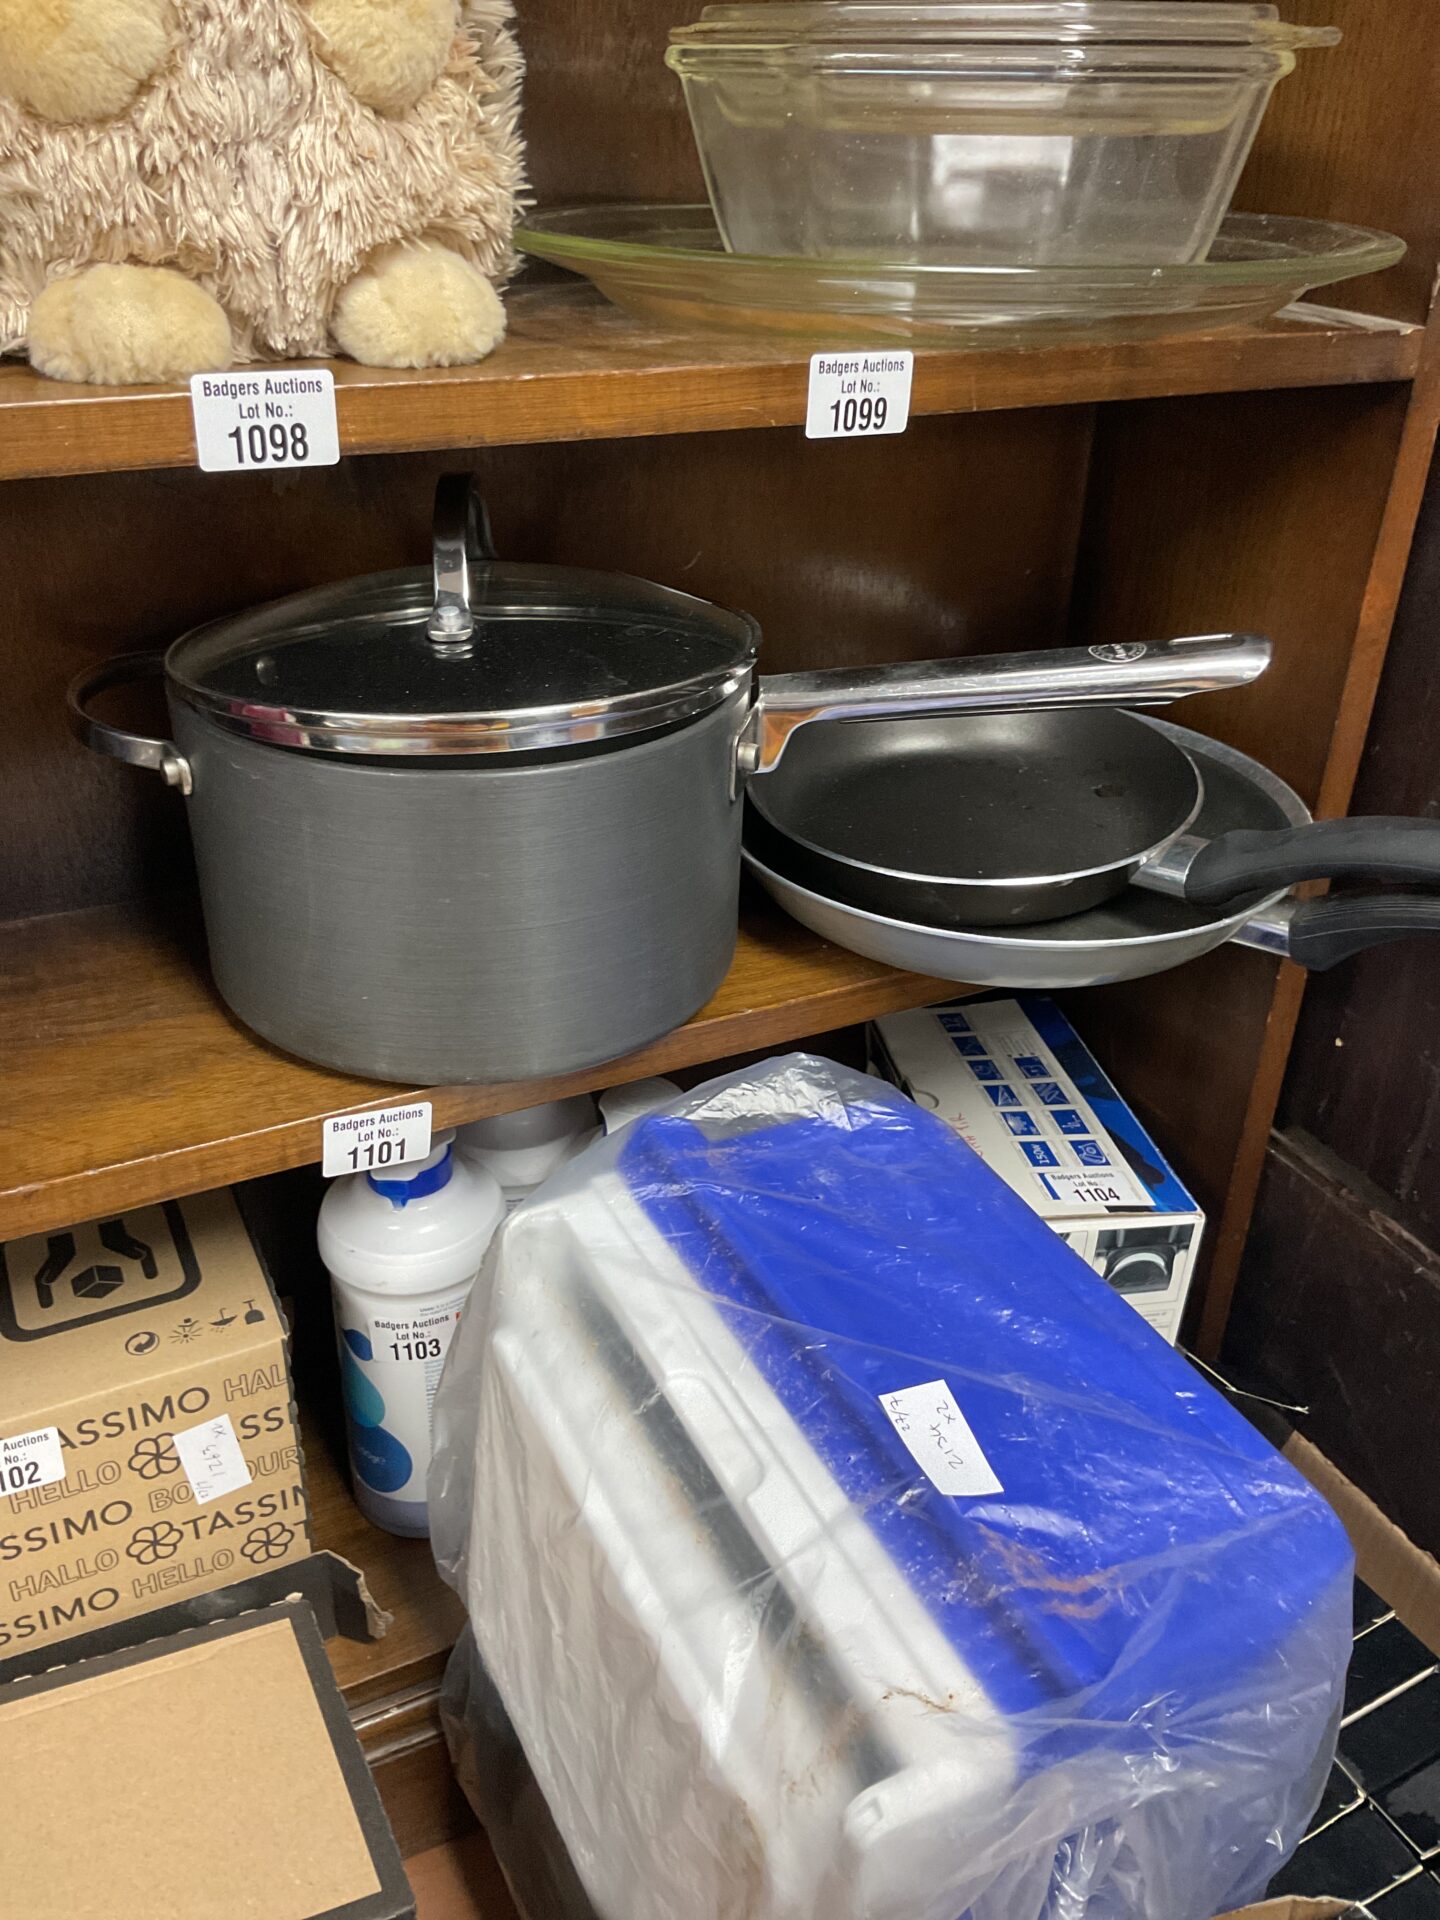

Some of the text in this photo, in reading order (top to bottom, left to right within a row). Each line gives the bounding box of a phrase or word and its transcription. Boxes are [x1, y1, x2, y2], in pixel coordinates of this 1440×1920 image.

[819, 359, 904, 376] Badgers Auctions
[203, 378, 323, 399] Badgers Auctions
[841, 379, 880, 394] Lot No.:
[239, 402, 293, 419] Lot No.:
[830, 397, 888, 432] 1099
[228, 422, 309, 464] 1098
[333, 1109, 424, 1132] Badgers Auctions
[358, 1128, 399, 1142] Lot No.:
[347, 1138, 406, 1169] 1101
[1051, 1173, 1082, 1181] Badgers
[1074, 1187, 1120, 1202] 1104
[374, 1315, 450, 1331] Badgers Auctions
[413, 1331, 431, 1340] No.:
[389, 1338, 441, 1361] 1103
[57, 1386, 210, 1450] ASSIMO
[3, 1433, 50, 1452] Auctions
[4, 1452, 28, 1465] No.:
[9, 1460, 122, 1515] HELLO
[9, 1548, 120, 1602] HALLO
[132, 1548, 236, 1599] HELLO
